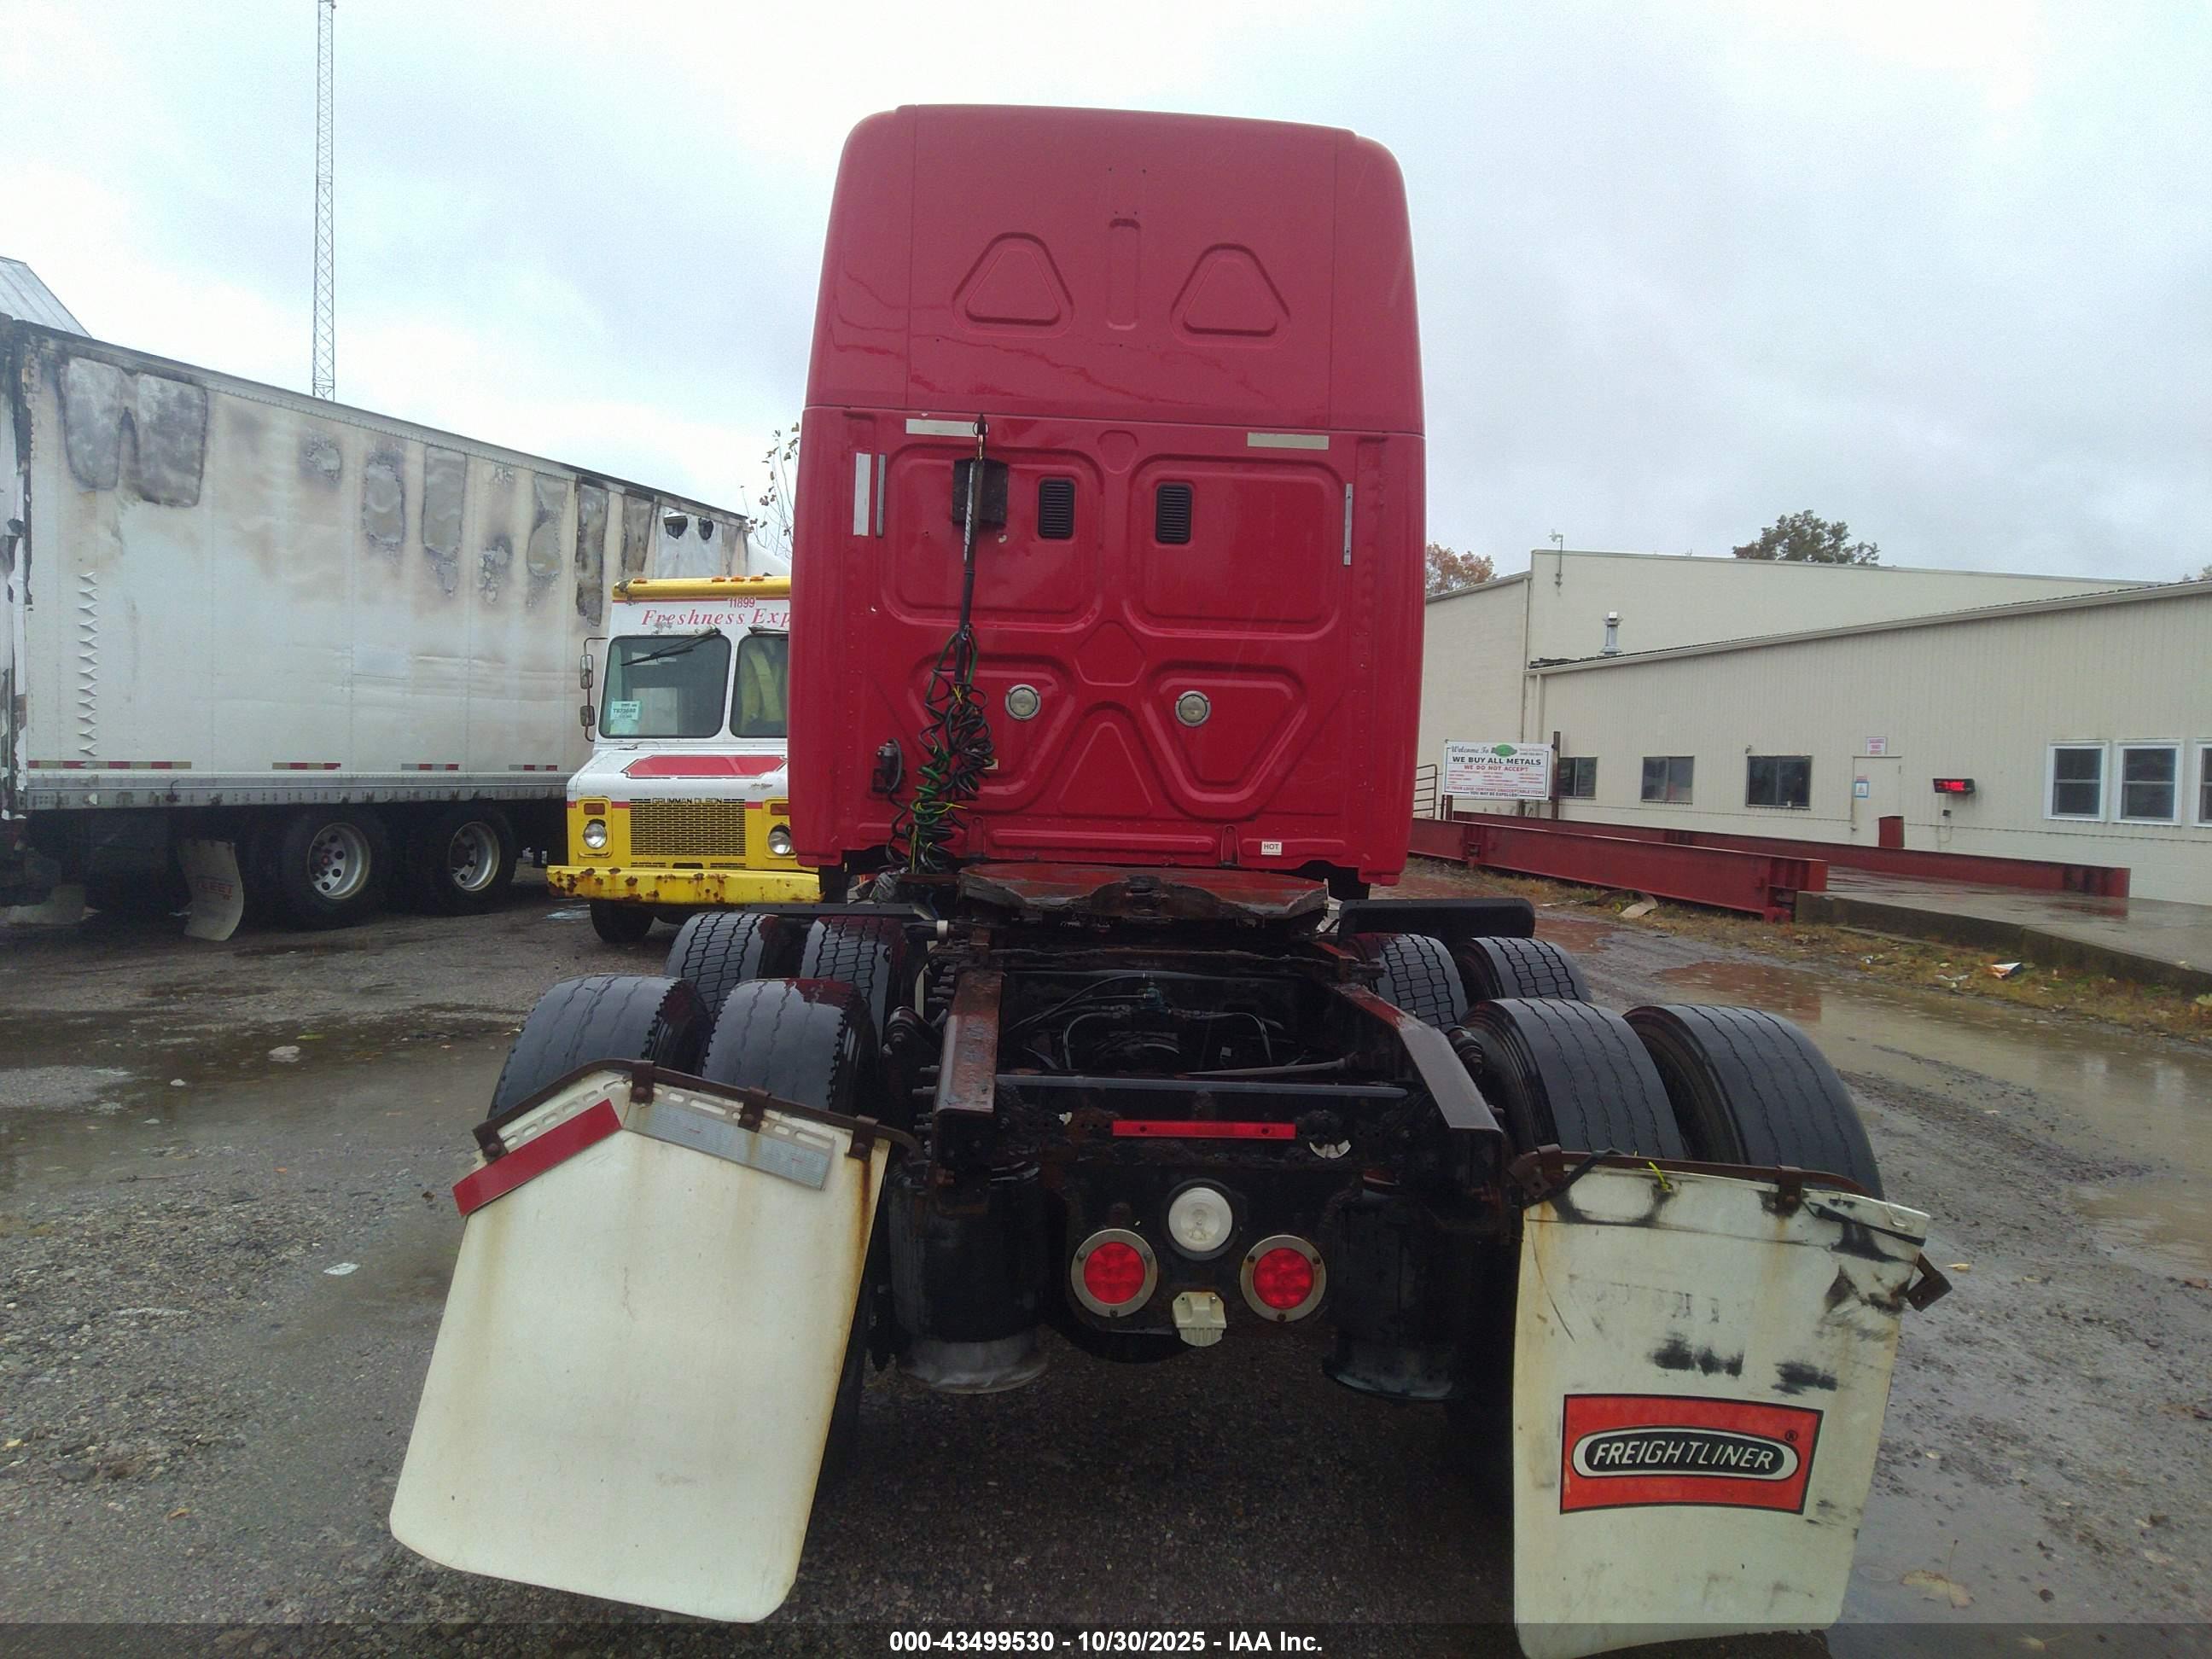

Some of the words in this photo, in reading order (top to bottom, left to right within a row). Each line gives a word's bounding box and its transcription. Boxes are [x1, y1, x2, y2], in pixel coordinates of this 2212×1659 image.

[729, 597, 755, 608] 11899
[642, 608, 745, 626] Freshness
[1451, 745, 1480, 754] Welcome
[1593, 1441, 1774, 1470] FREIGHTLINER
